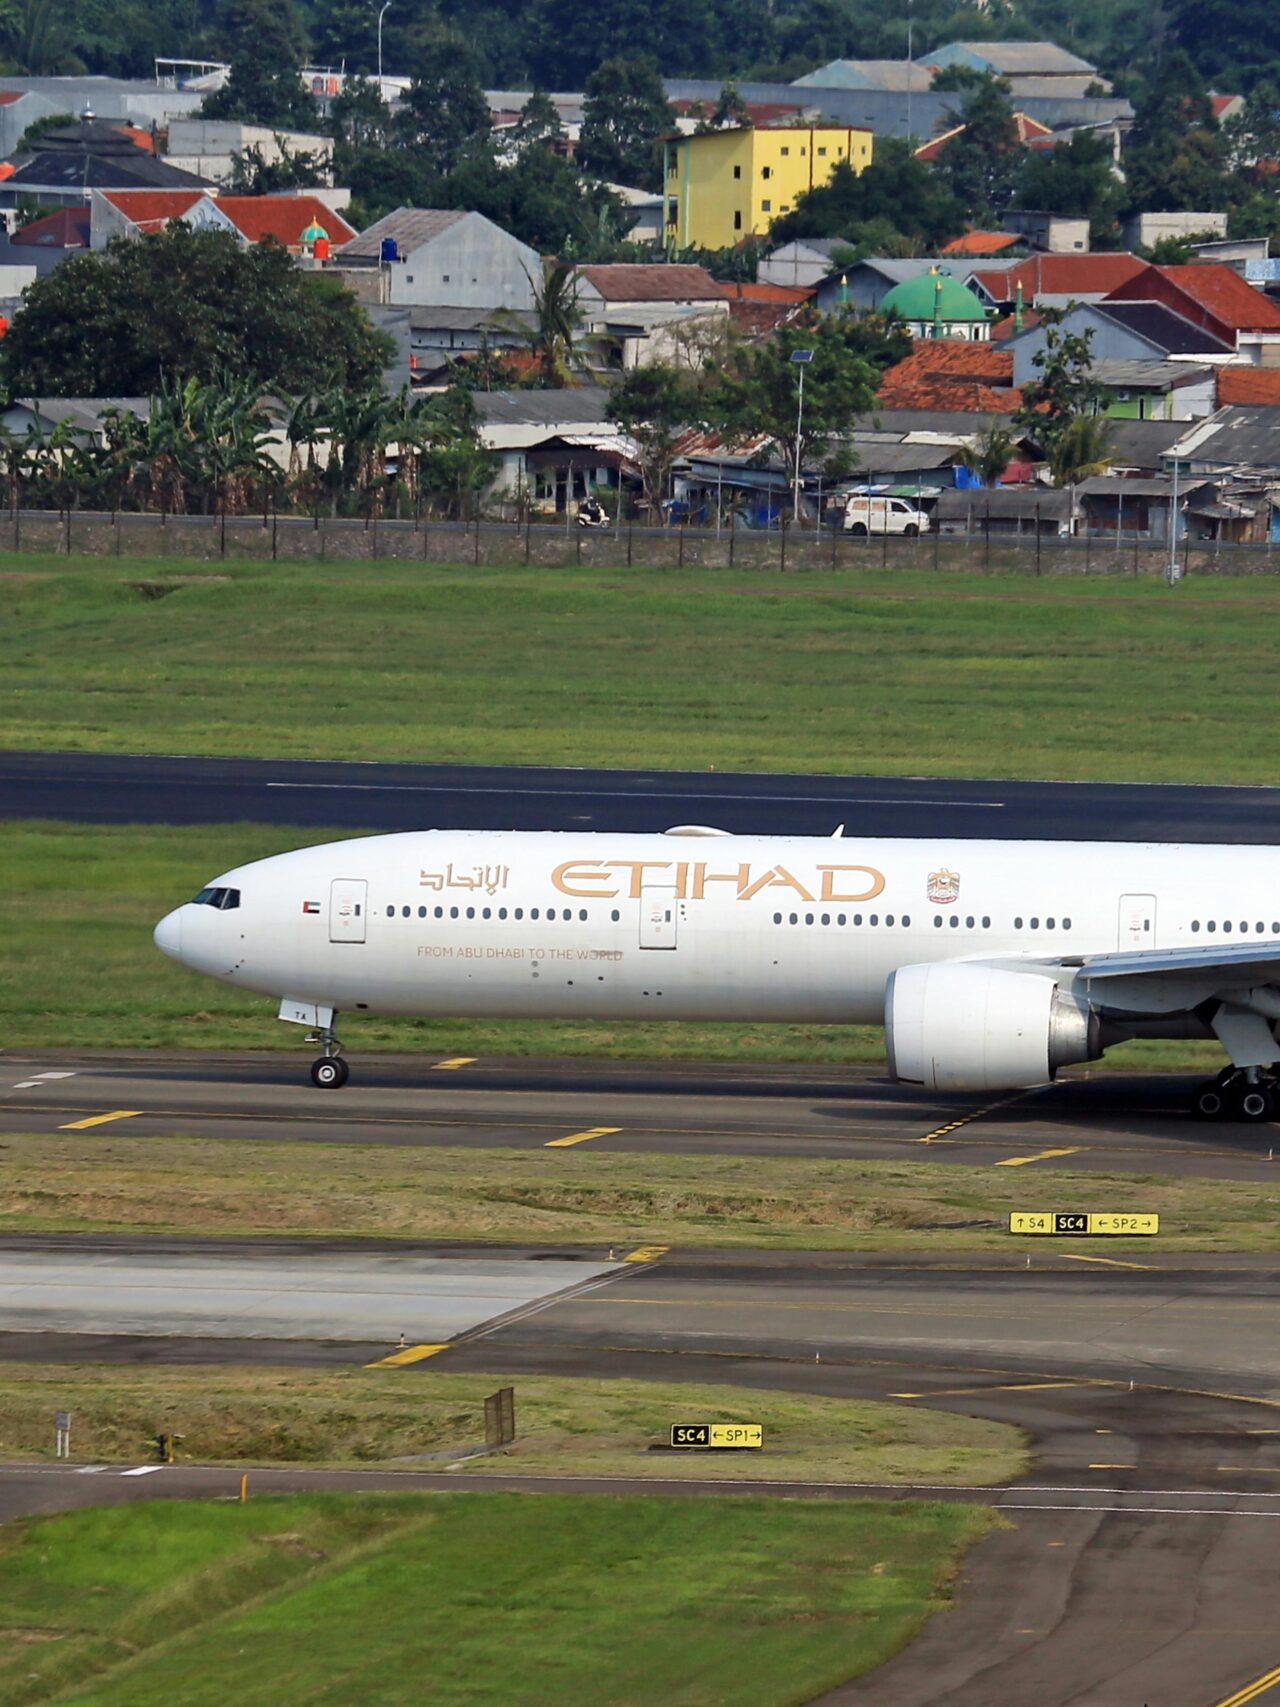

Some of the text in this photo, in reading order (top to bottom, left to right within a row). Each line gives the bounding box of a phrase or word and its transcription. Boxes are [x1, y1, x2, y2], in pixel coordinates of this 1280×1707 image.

[550, 860, 886, 902] ETIHAD
[417, 946, 624, 961] FROM ABU DHABI TO THE WORLD
[295, 1010, 306, 1020] TA
[1028, 1217, 1138, 1230] S4 SC4 SP2
[677, 1428, 749, 1442] SC4 SP1
